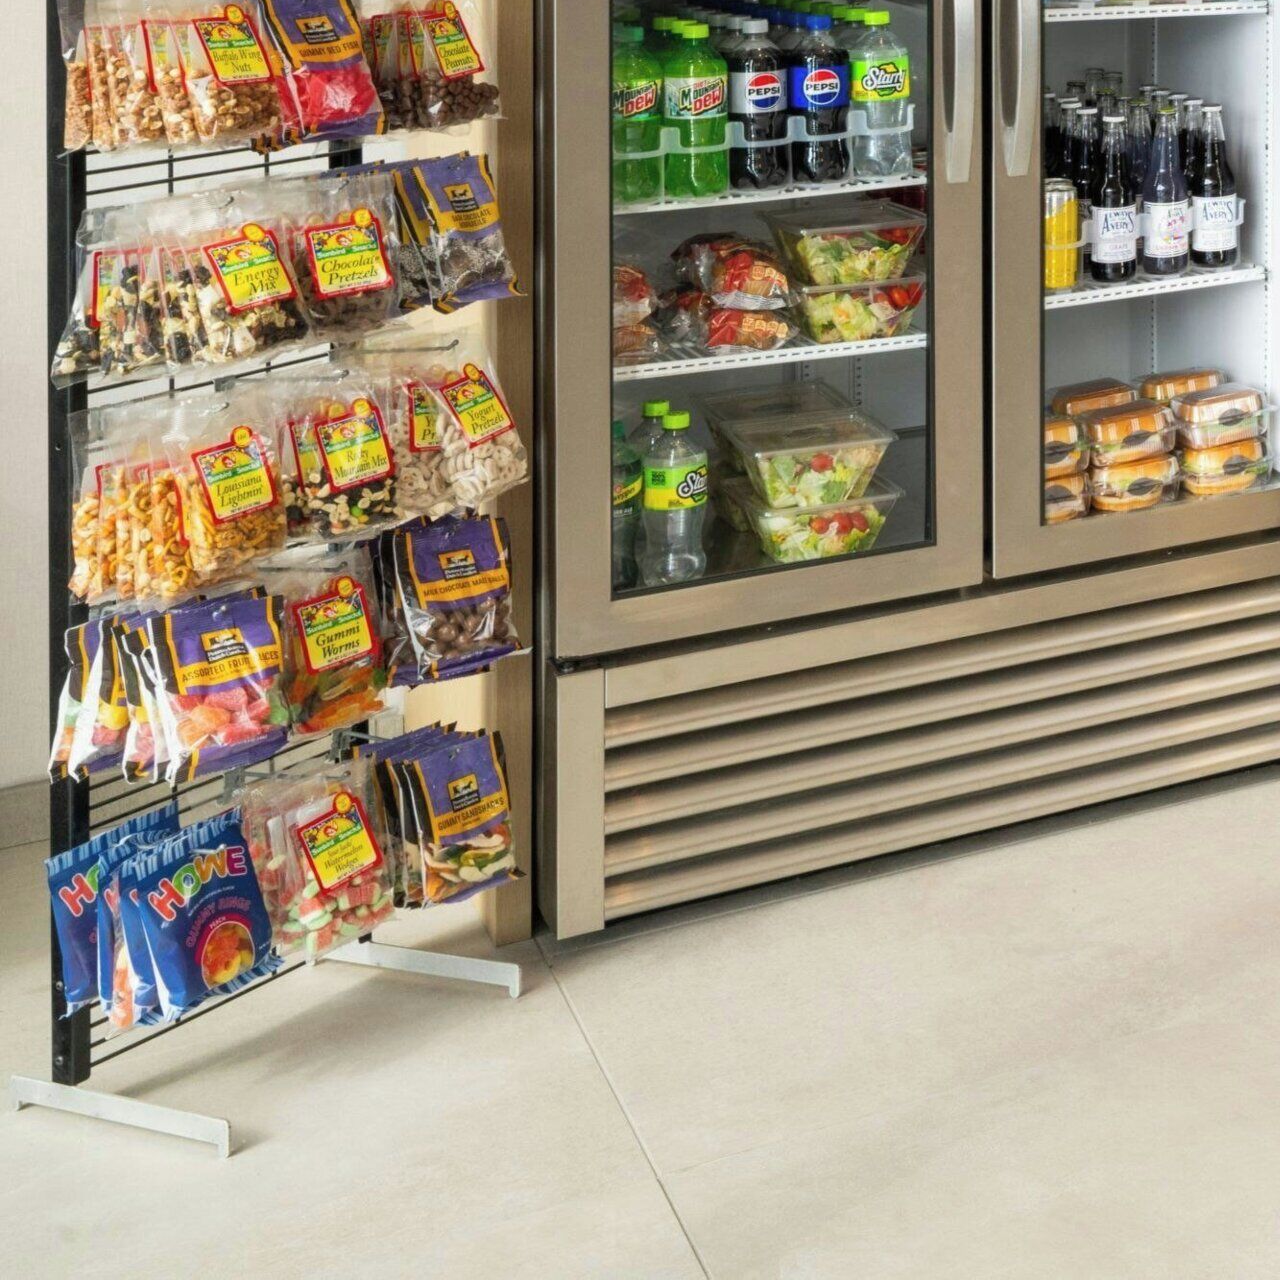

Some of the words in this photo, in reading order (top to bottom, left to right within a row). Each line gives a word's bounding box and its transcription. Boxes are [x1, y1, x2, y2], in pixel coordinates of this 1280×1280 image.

[326, 45, 342, 55] RED
[342, 40, 360, 53] FISH
[439, 45, 471, 60] Chocolate
[231, 62, 252, 73] Nuts
[443, 55, 473, 69] Peanuts
[748, 86, 780, 97] PEPSI
[805, 81, 839, 92] PEPSI
[232, 265, 280, 287] Energy
[328, 268, 379, 286] Pretzels
[249, 279, 277, 296] Mix
[466, 403, 496, 422] Yogurt
[471, 413, 505, 435] Pretzels
[371, 454, 387, 467] Mix
[216, 473, 262, 497] Louisiana
[315, 621, 361, 648] Gummi
[322, 638, 361, 659] Worms
[182, 663, 226, 682] ASSORTED
[437, 815, 462, 831] GUMMY
[147, 844, 248, 922] HOWE
